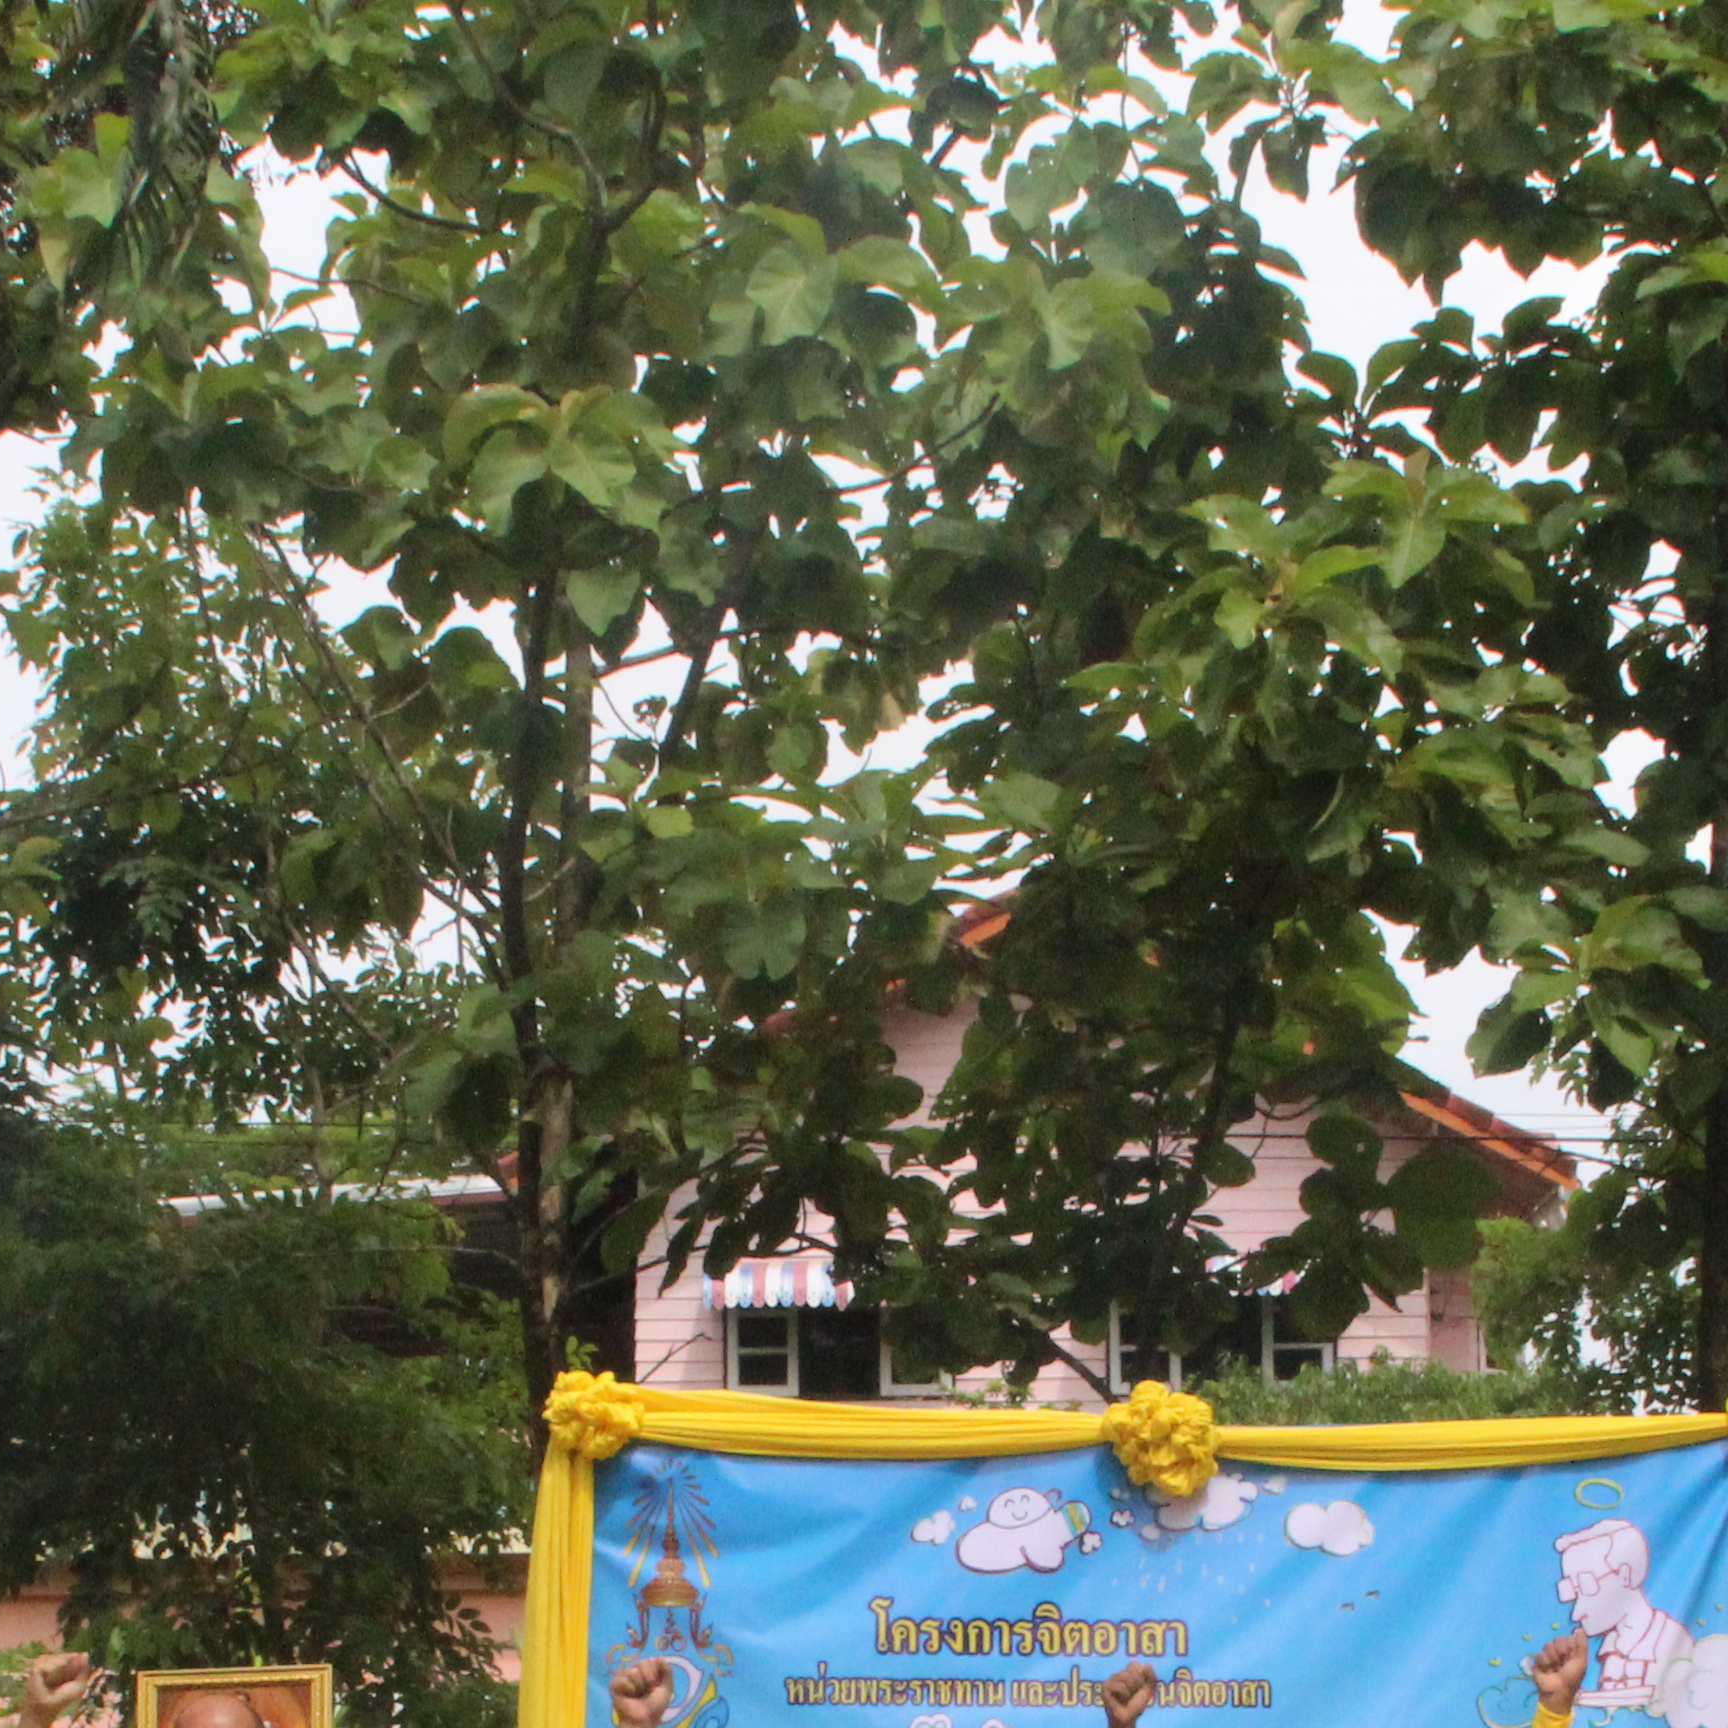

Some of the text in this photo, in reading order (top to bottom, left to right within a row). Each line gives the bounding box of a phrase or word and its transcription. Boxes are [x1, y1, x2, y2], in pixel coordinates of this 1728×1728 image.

[869, 1597, 1189, 1658] โครงการจิตอาสา
[785, 1662, 1273, 1709] หน่วยพระราชทาน และประนจิตอาสา
